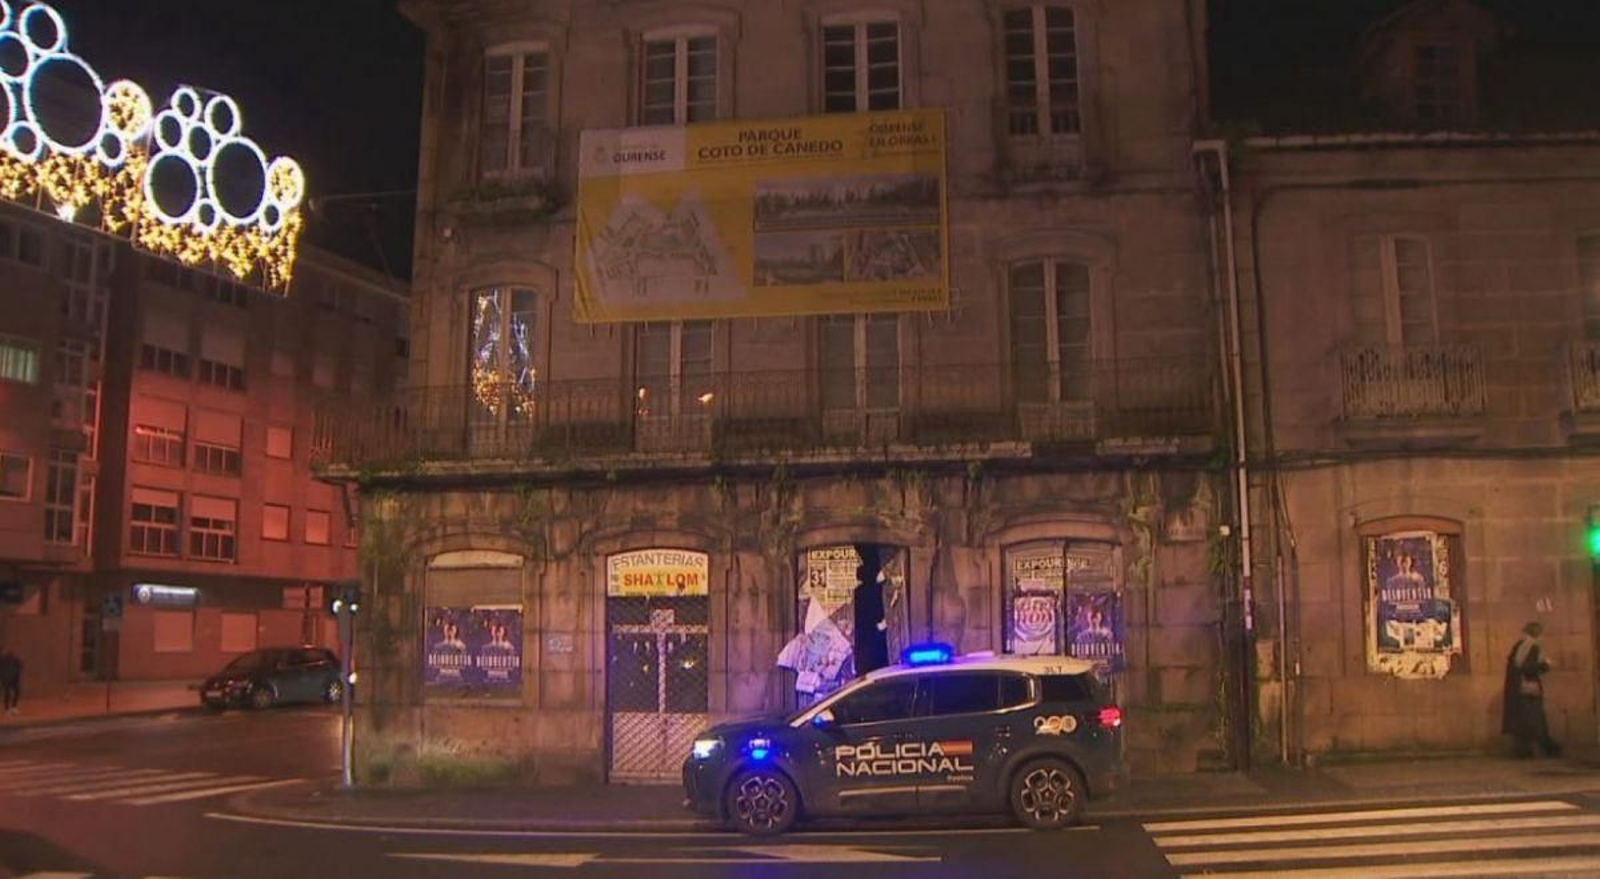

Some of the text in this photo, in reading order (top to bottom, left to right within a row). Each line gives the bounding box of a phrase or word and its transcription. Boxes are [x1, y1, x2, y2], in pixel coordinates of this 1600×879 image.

[738, 128, 802, 142] PARQUE
[613, 149, 666, 163] OURENSE
[698, 139, 843, 159] COTO DE CANEDO
[611, 553, 704, 571] ESTANTERIAS
[836, 758, 974, 777] NACIONAL
